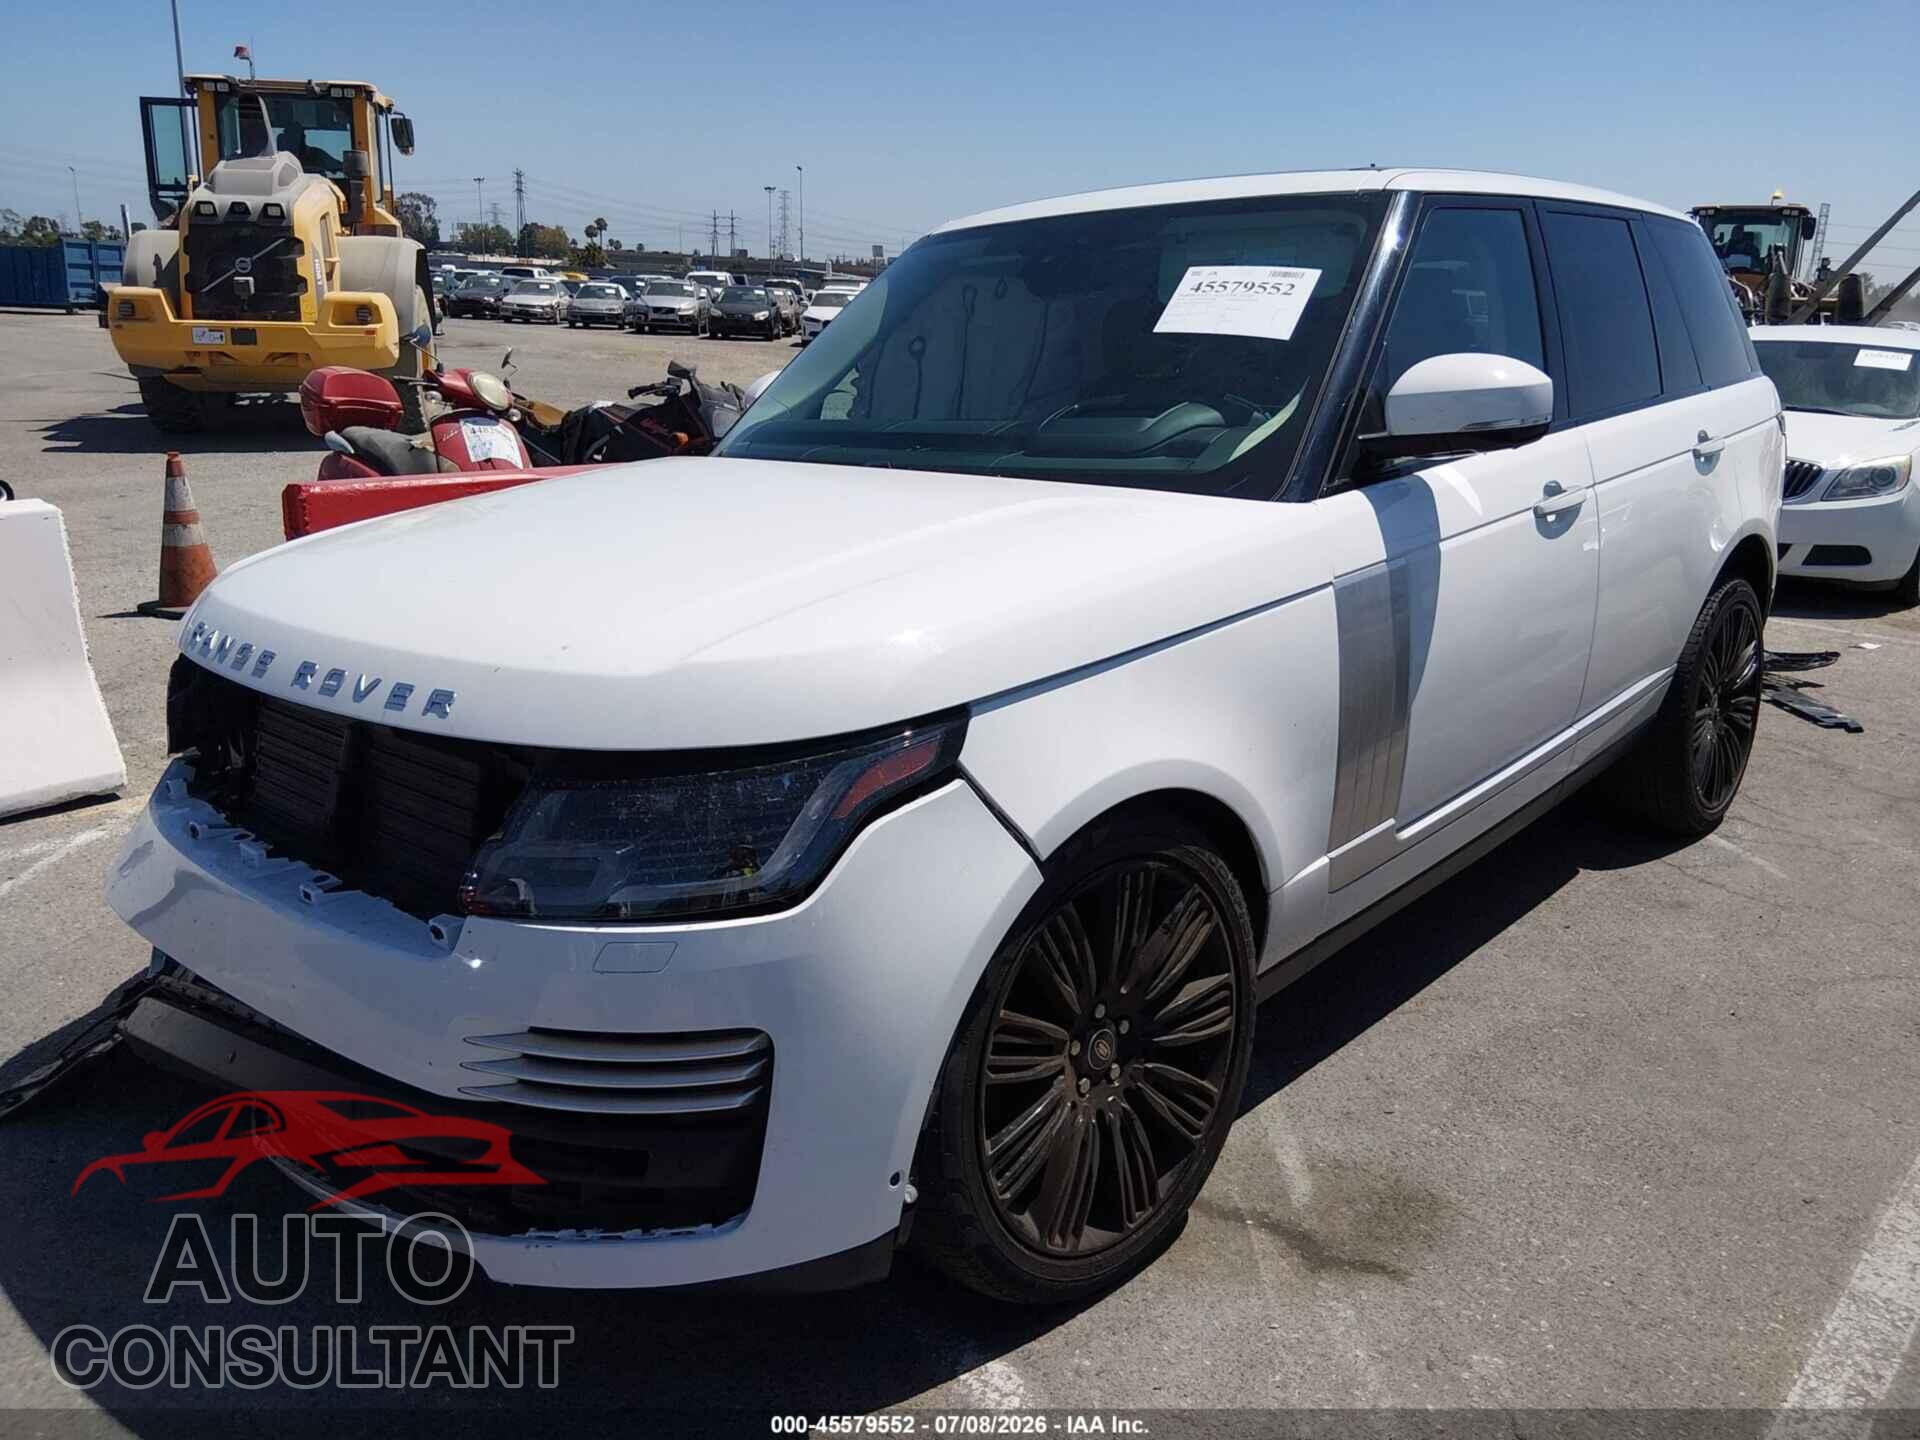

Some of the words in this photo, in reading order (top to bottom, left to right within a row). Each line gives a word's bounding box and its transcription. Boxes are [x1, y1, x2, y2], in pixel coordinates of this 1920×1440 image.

[1190, 281, 1295, 296] 45579552
[187, 620, 277, 679] RANGE
[290, 660, 457, 719] ROVER
